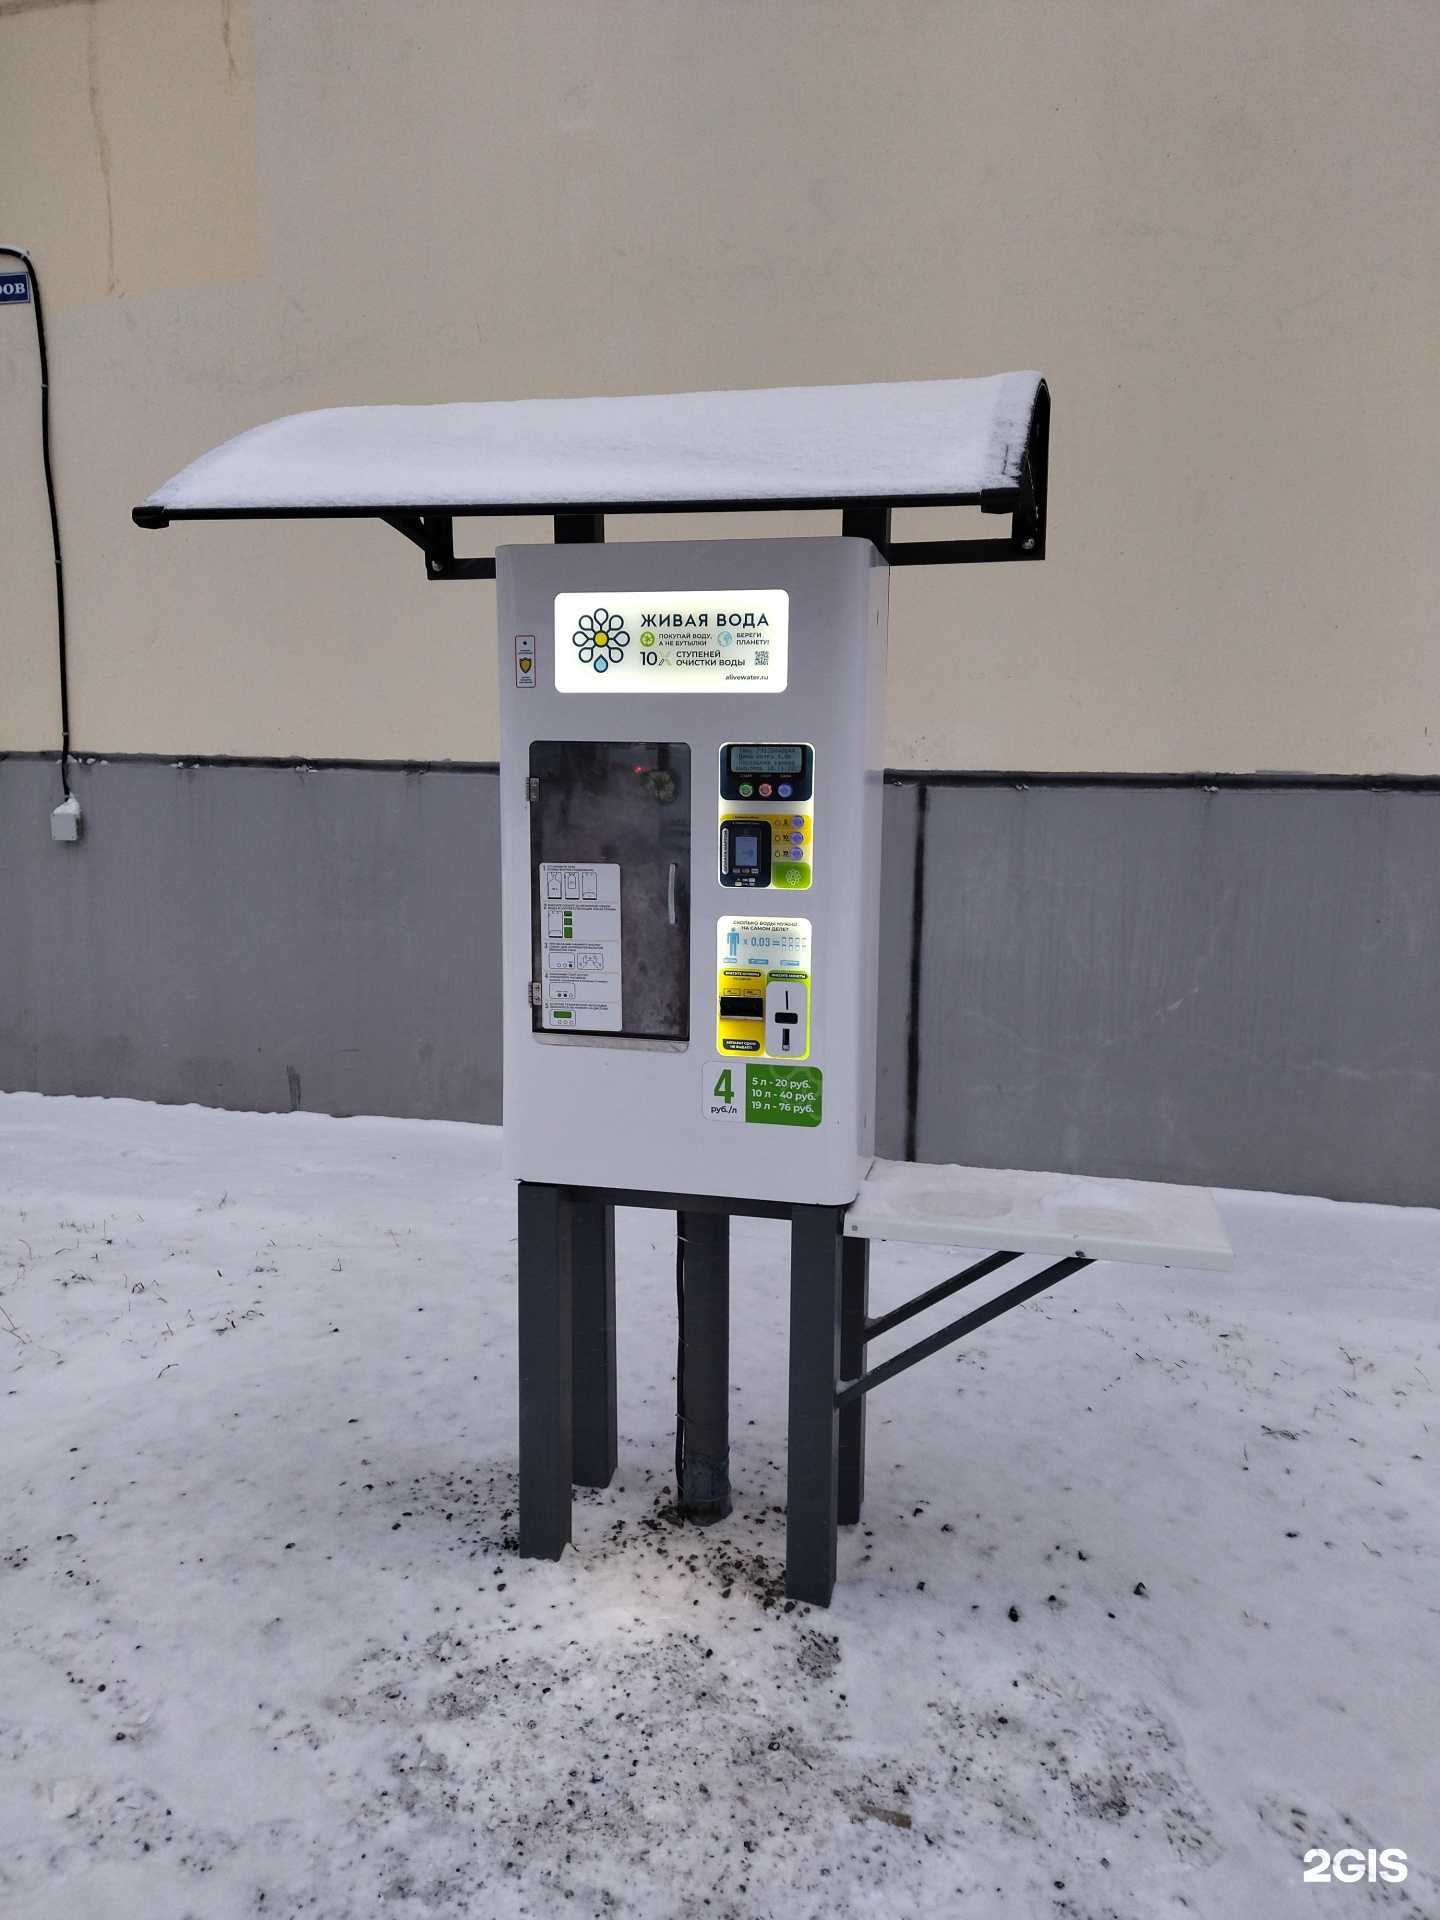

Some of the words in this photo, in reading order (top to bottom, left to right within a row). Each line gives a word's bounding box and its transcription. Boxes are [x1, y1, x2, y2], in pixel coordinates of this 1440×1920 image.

[640, 613, 708, 627] ЖИВАЯ
[716, 613, 769, 628] ВОДА
[640, 651, 658, 666] 10
[676, 650, 721, 658] СТУПЕНЕЙ
[719, 659, 745, 667] ВОДЫ
[713, 1069, 735, 1104] 4
[752, 1077, 758, 1085] 5
[775, 1079, 788, 1087] 20
[790, 1080, 811, 1089] руб.
[752, 1089, 762, 1097] 10
[779, 1091, 793, 1099] 40
[795, 1092, 816, 1101] руб.
[711, 1106, 738, 1114] руб./л
[752, 1101, 761, 1109] 19
[779, 1103, 791, 1111] 76
[793, 1104, 814, 1113] руб.
